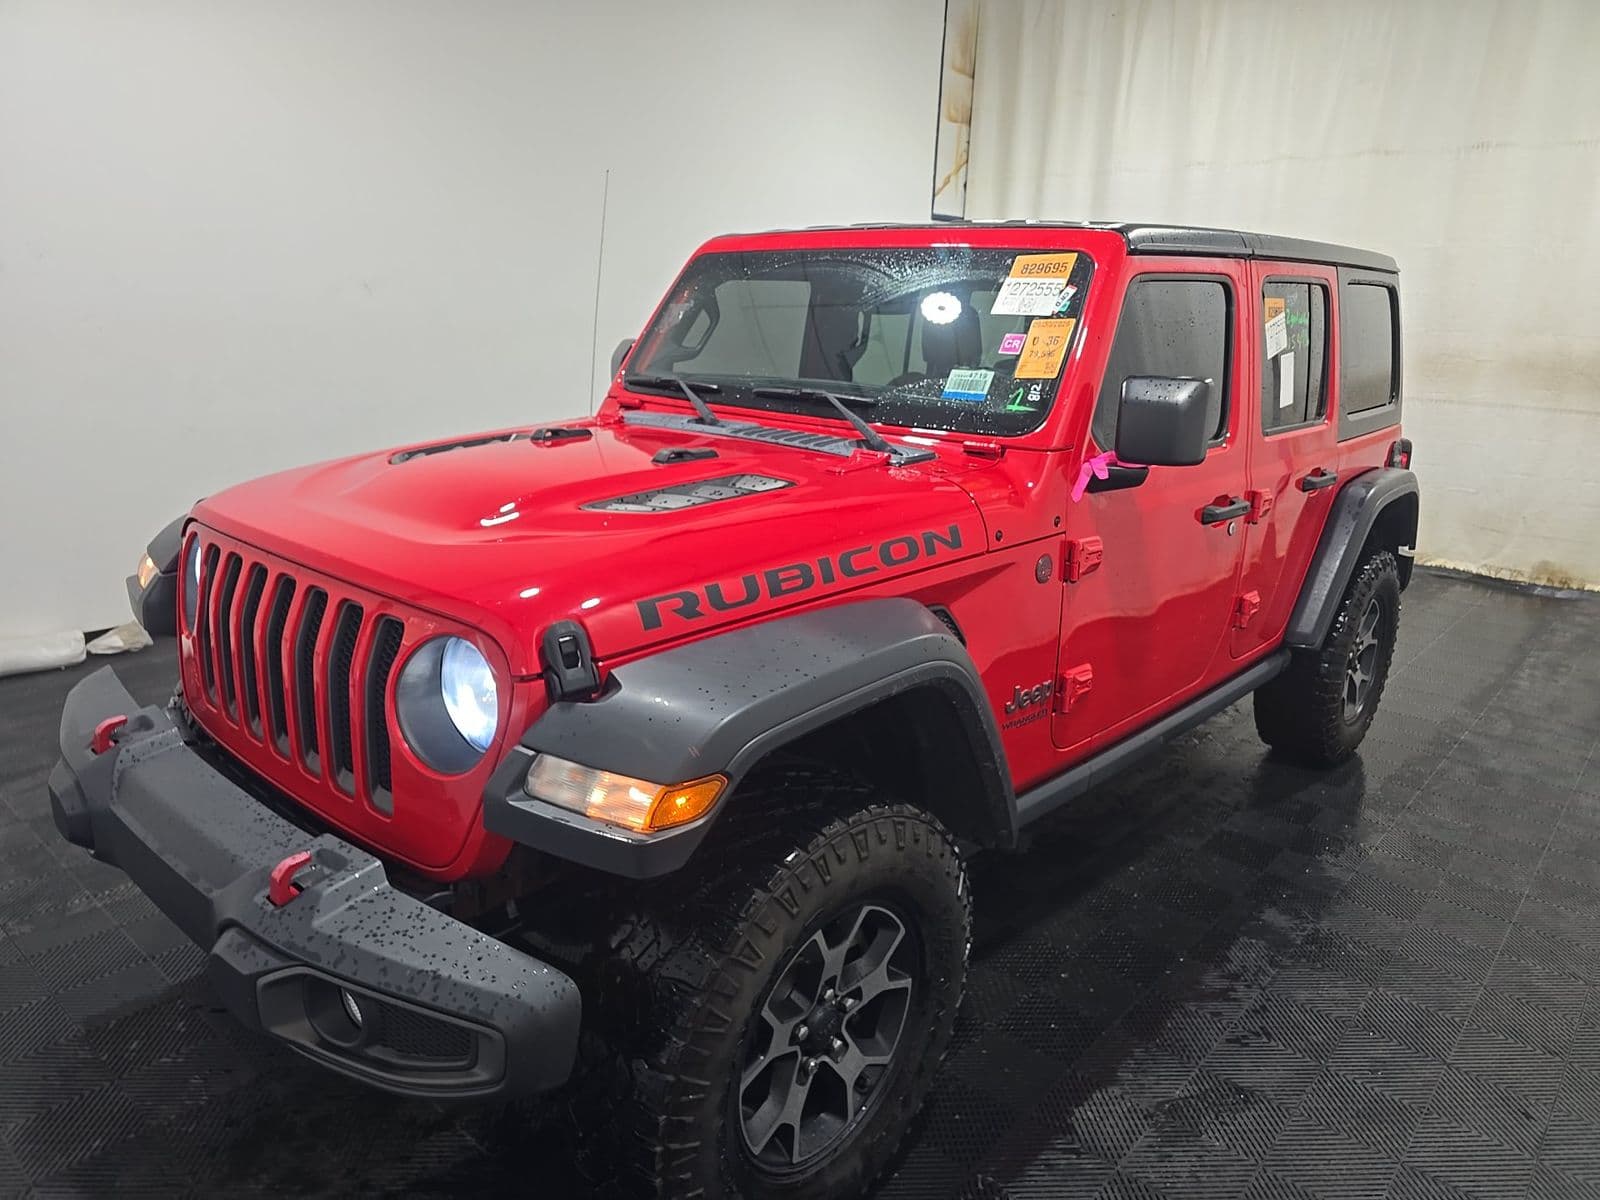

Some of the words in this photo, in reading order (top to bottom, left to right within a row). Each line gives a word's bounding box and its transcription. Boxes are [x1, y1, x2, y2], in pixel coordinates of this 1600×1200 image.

[1020, 262, 1069, 275] 829695
[1004, 339, 1021, 349] CR
[636, 524, 963, 632] RUBICON
[1005, 680, 1053, 714] Jeep
